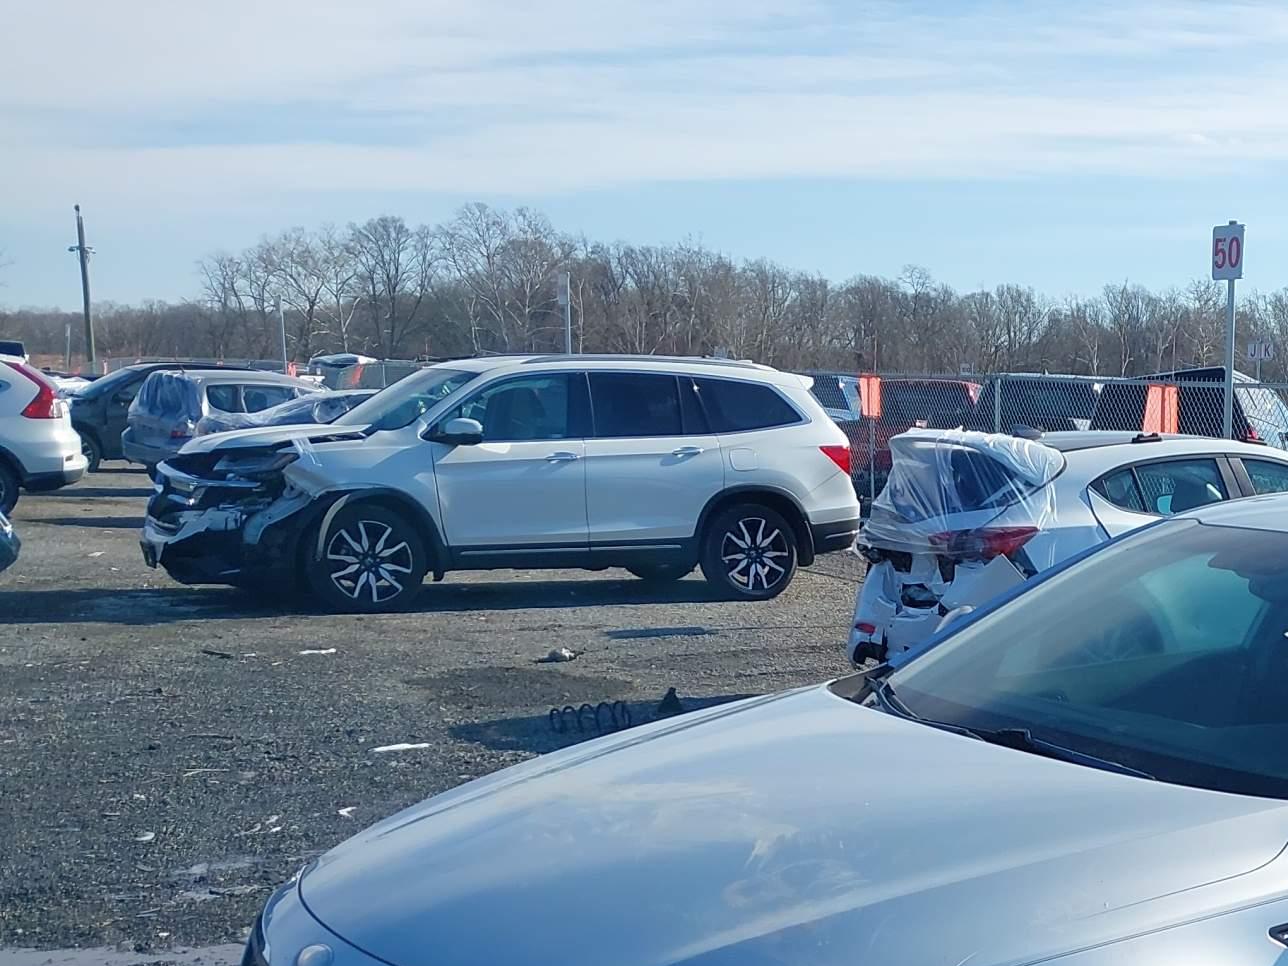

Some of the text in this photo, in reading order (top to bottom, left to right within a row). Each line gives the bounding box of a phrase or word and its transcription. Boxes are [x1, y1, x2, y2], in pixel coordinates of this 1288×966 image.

[1214, 236, 1241, 269] 50
[1250, 343, 1271, 358] J K
